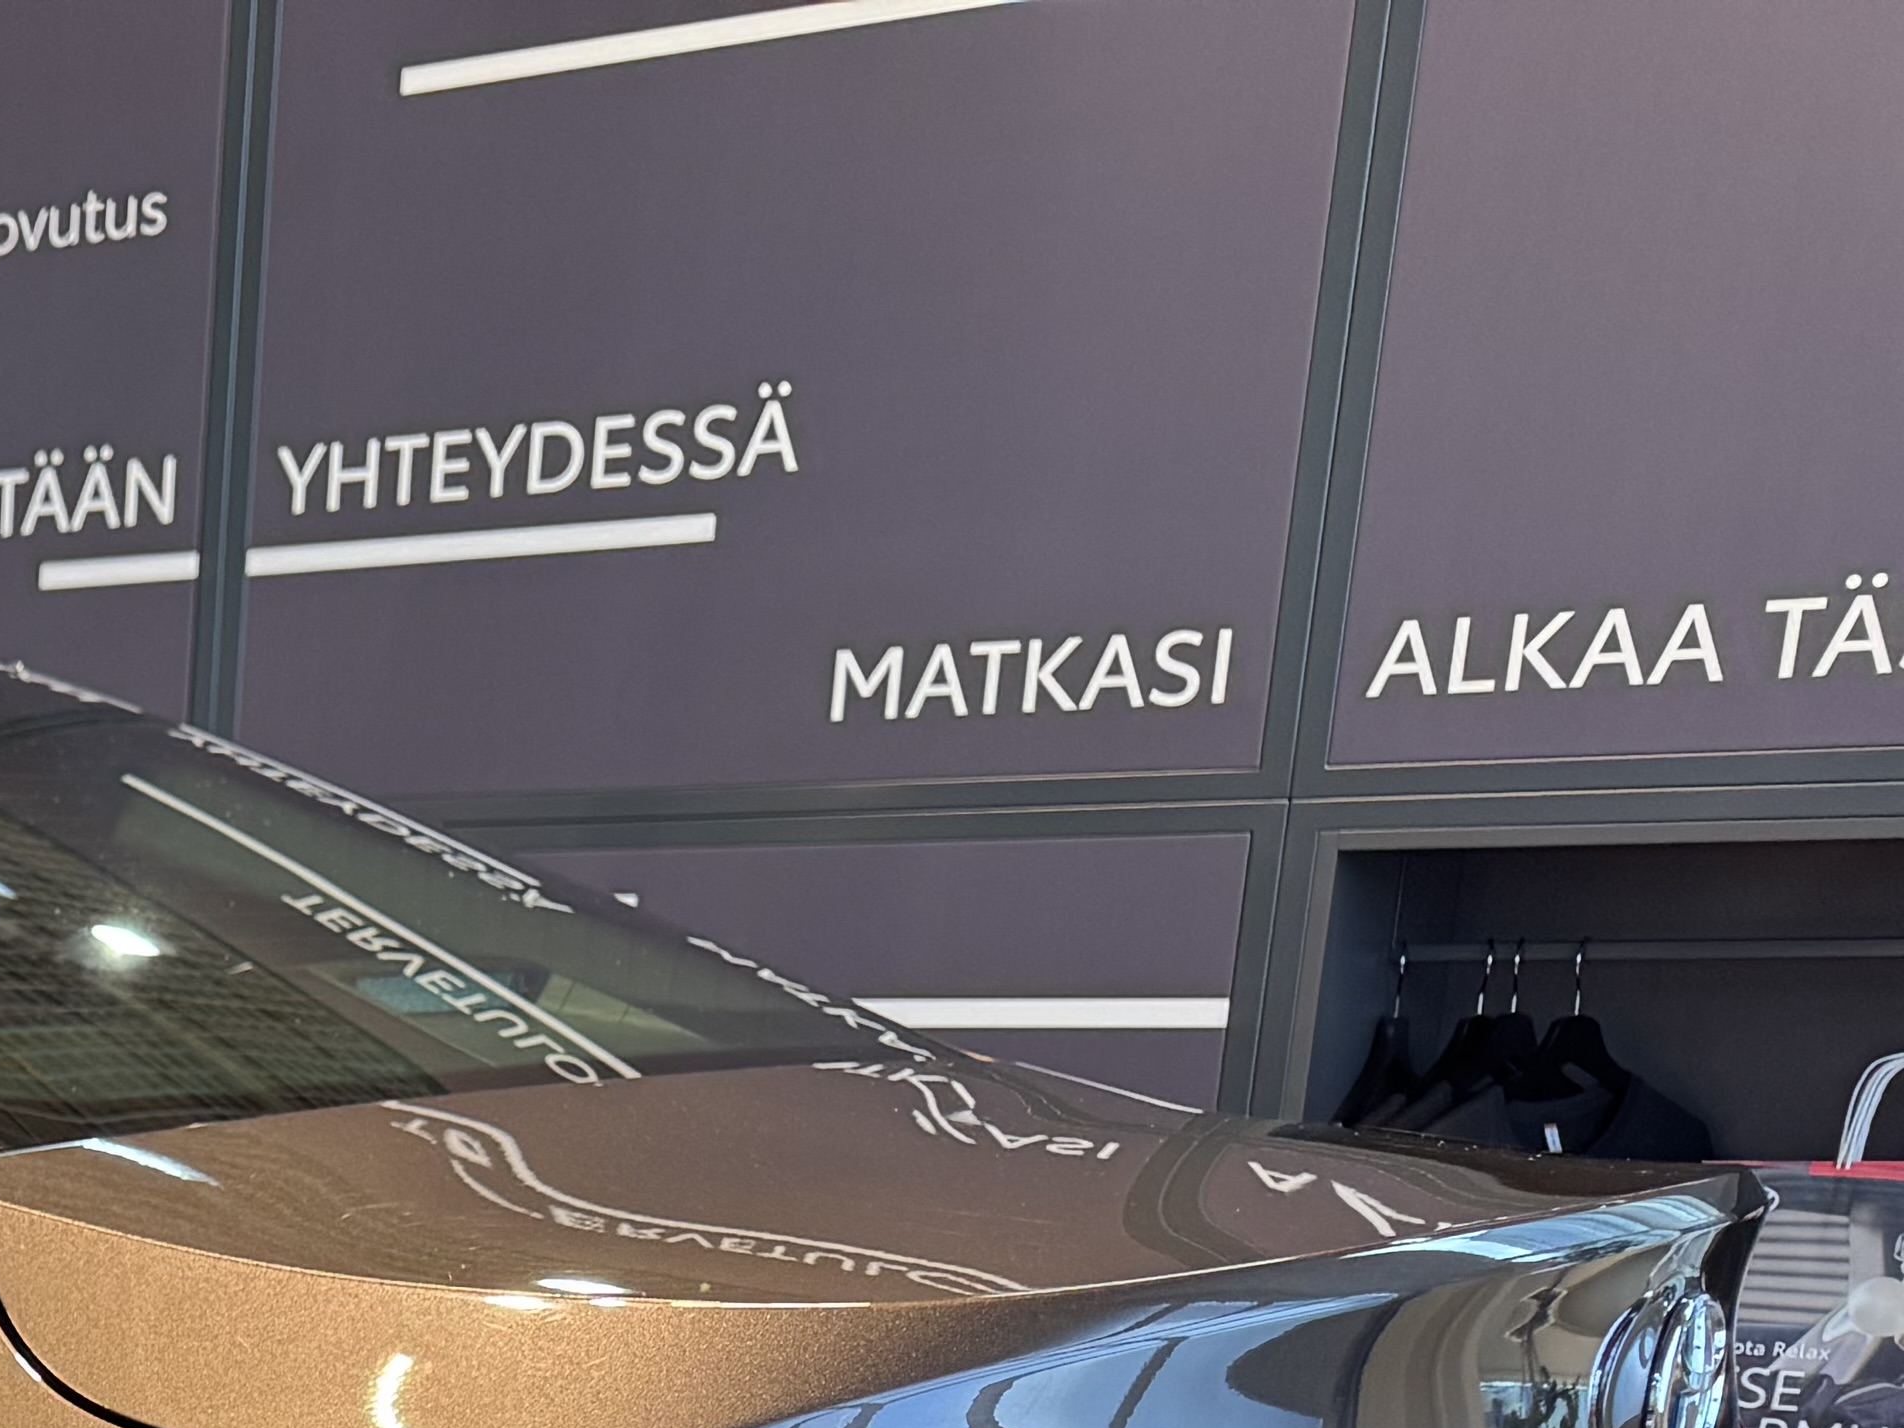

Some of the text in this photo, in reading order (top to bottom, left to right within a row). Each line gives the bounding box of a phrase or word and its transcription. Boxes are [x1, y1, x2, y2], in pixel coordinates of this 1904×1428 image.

[276, 381, 799, 515] YHTEYDESSÄ
[829, 572, 1904, 722] MATKASI ALKAA TÄ
[1736, 1366, 1806, 1412] SE
[1772, 1340, 1831, 1361] Relax
